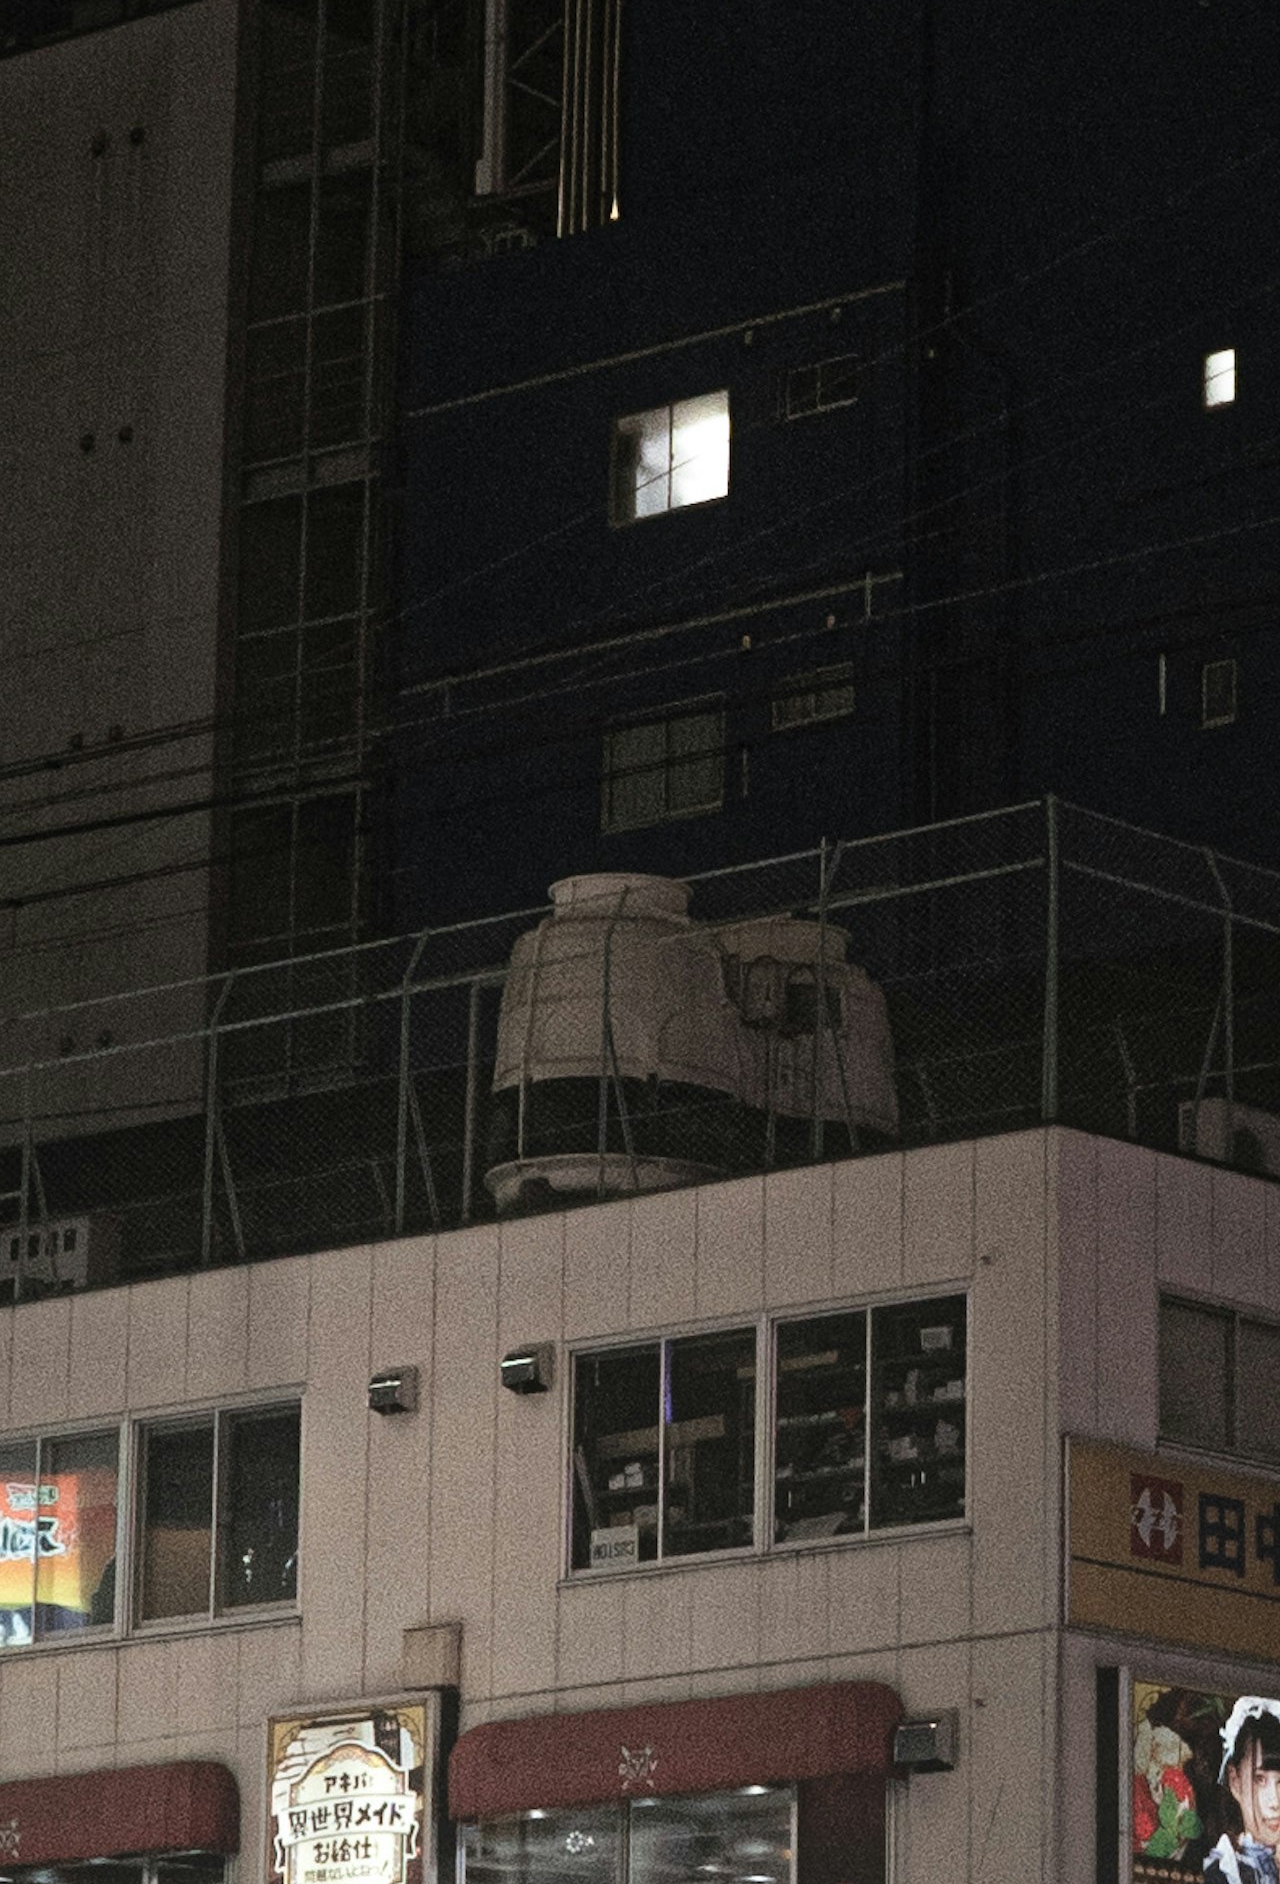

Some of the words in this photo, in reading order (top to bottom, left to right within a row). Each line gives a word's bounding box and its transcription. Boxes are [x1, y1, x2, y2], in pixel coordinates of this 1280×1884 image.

[288, 1800, 406, 1839] 異世界メイド
